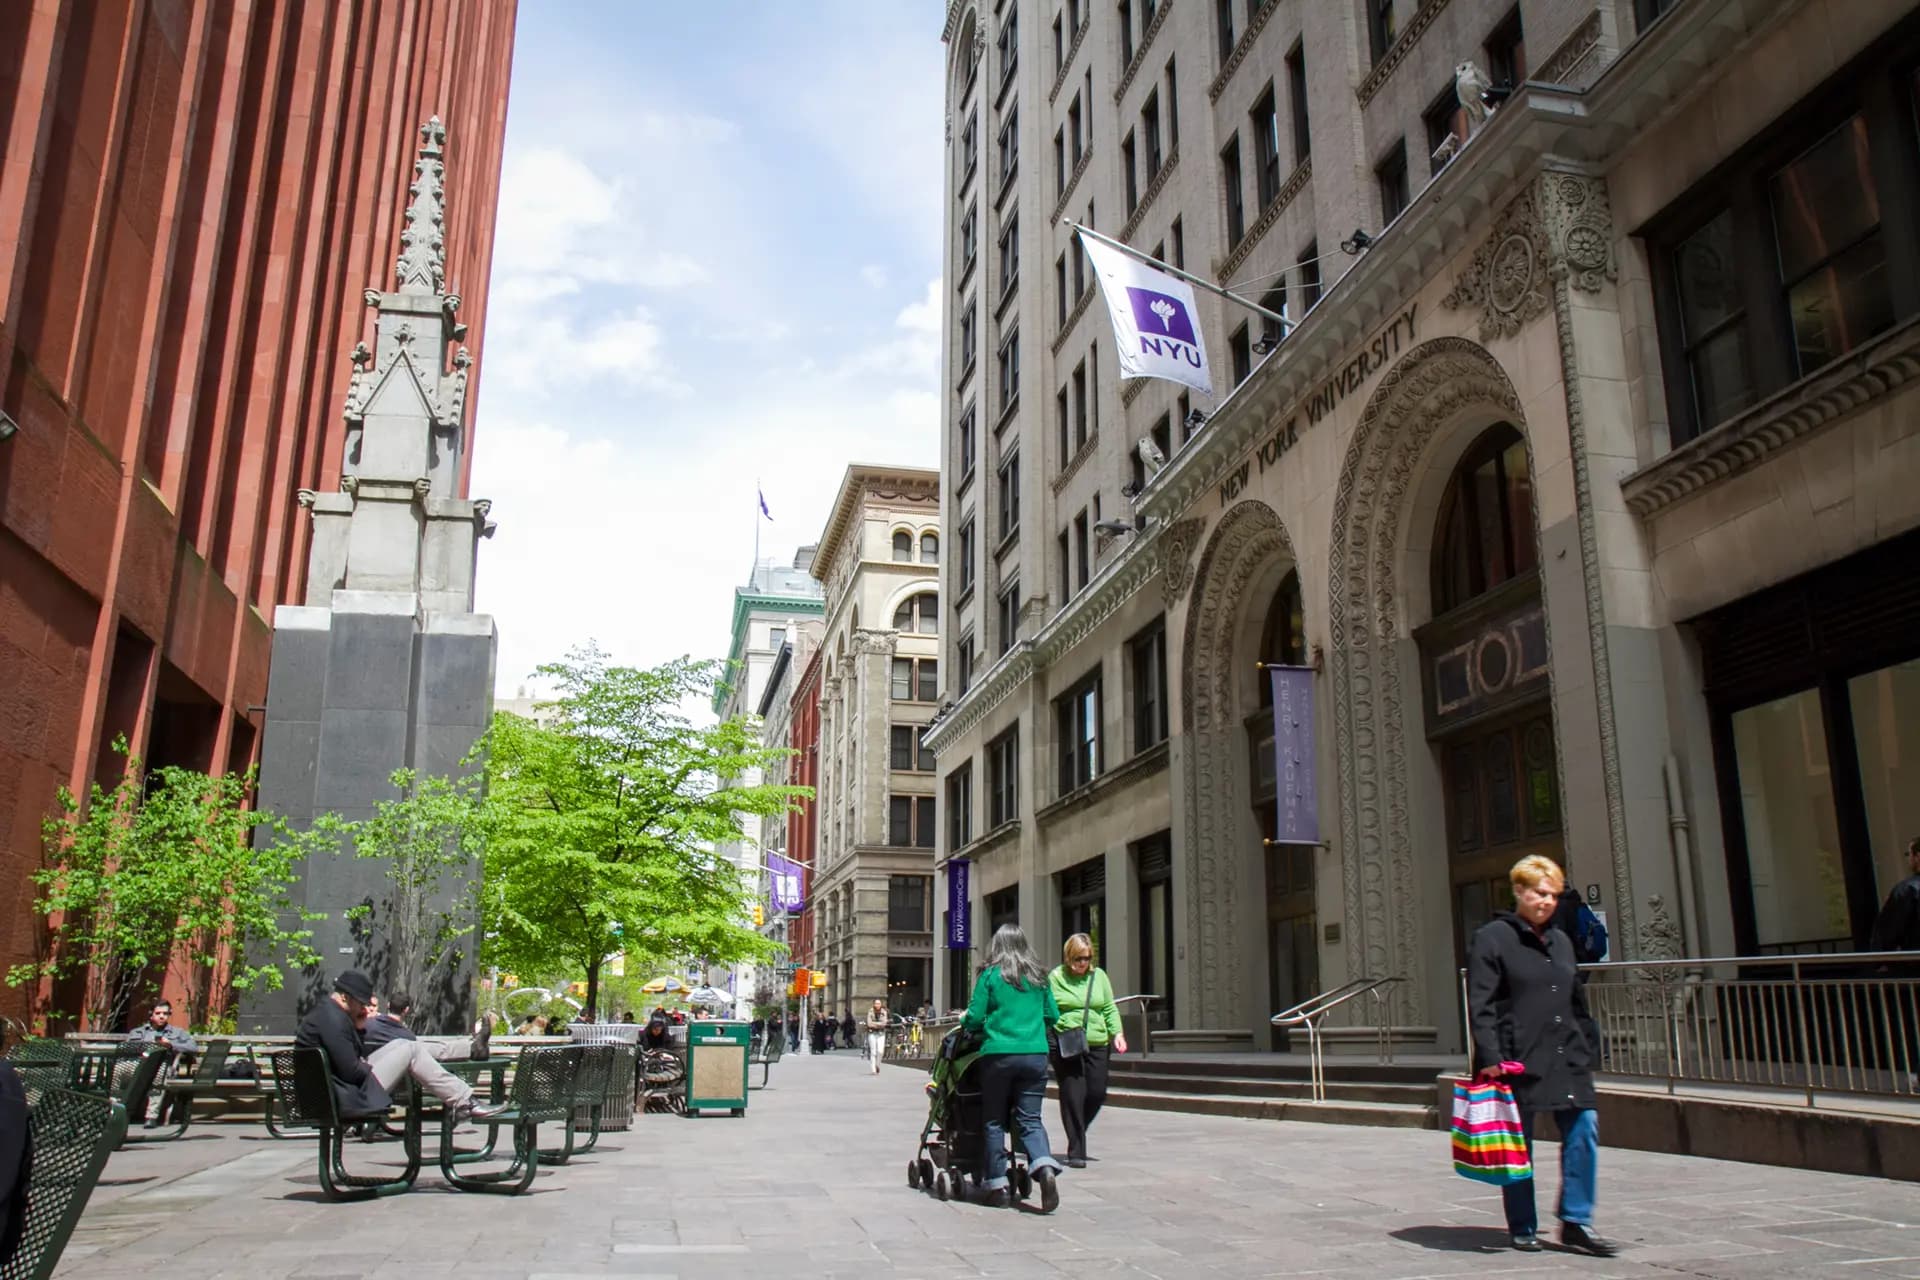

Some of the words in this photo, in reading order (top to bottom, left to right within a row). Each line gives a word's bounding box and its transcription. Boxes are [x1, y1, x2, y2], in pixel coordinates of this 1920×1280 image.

[1139, 335, 1201, 369] NYU
[1219, 459, 1250, 507] NEW
[1256, 417, 1299, 475] YORK
[1284, 746, 1297, 833] KAUFMAN
